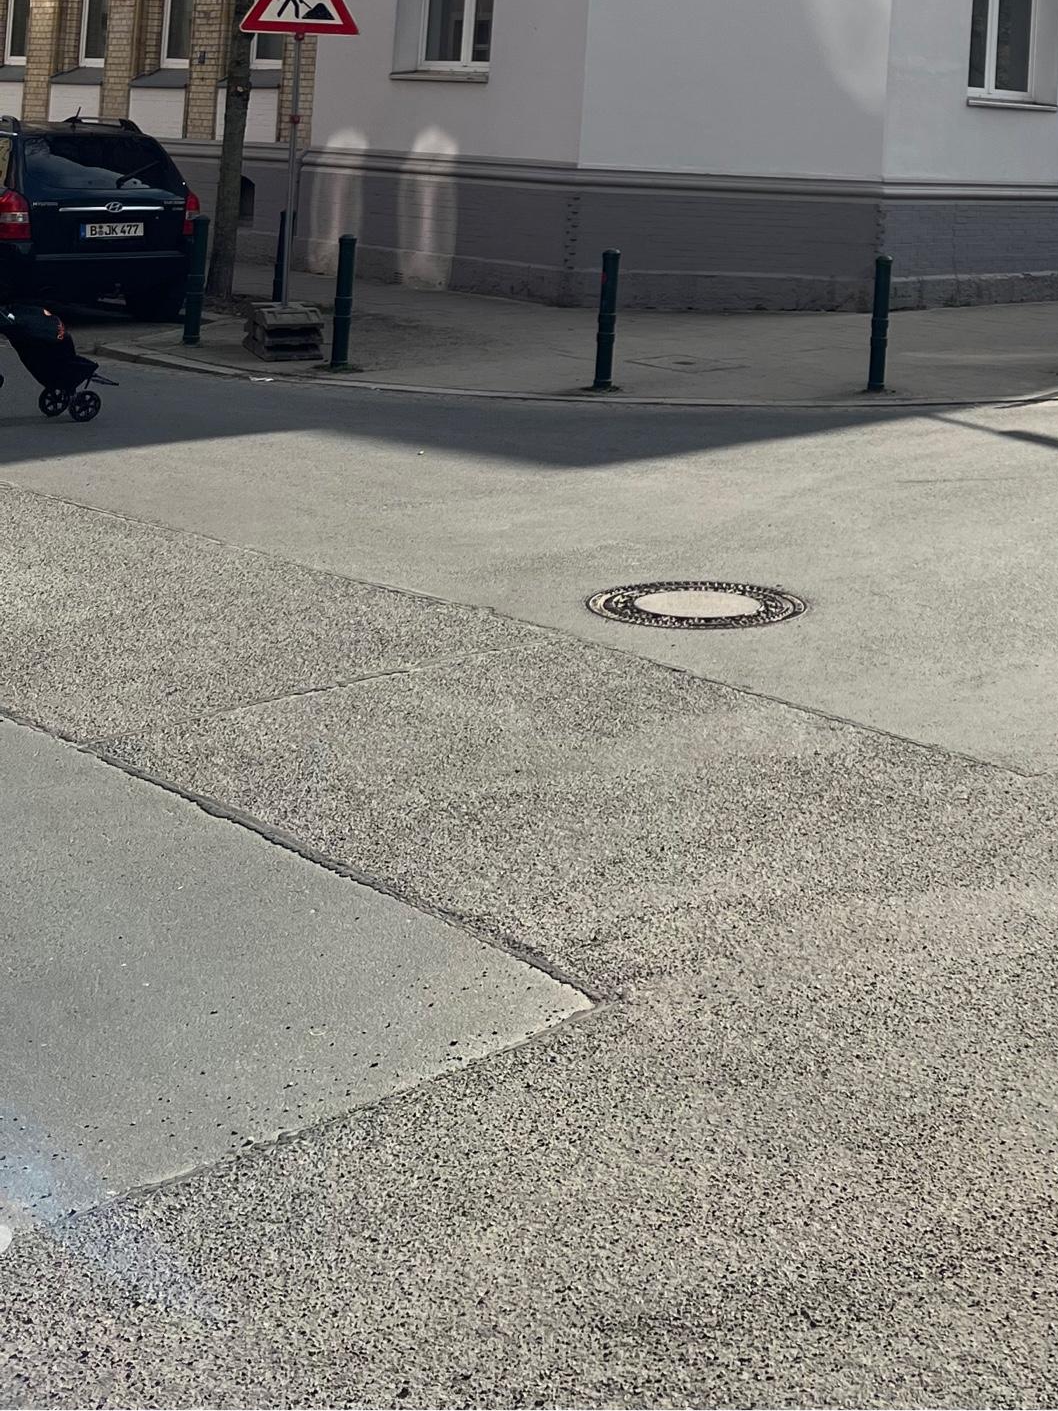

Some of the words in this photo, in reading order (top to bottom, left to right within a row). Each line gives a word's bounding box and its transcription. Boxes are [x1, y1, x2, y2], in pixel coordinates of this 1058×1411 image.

[90, 225, 97, 236] B
[105, 225, 118, 236] JK
[120, 224, 139, 235] 477
